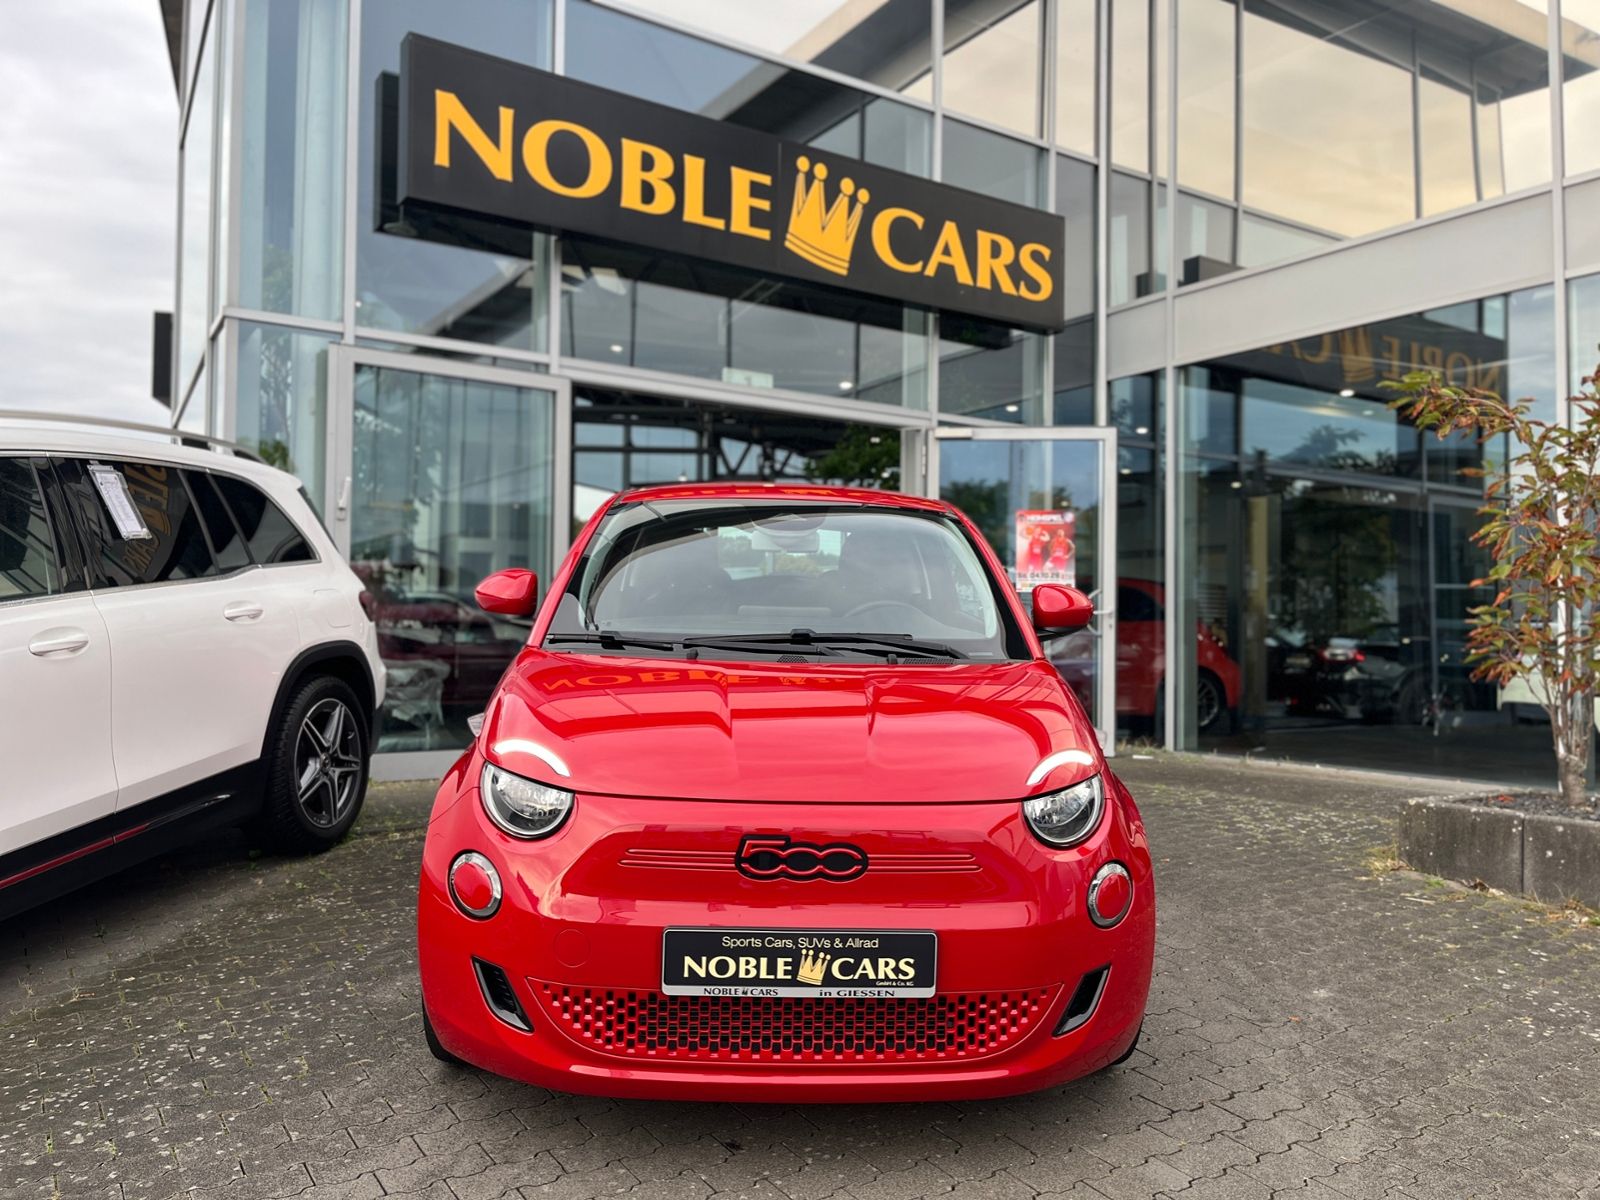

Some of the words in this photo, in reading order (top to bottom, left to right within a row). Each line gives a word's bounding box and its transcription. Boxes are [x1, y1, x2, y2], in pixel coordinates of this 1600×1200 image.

[434, 88, 772, 241] NOBLE
[871, 207, 1053, 302] CARS
[735, 834, 869, 883] 500
[721, 936, 762, 949] Sports
[764, 936, 796, 949] Cars,
[798, 937, 831, 949] SUVs
[833, 938, 843, 948] &
[845, 937, 879, 949] Allrad
[683, 955, 793, 980] NOBLE
[831, 957, 915, 980] CARS
[703, 987, 740, 996] NOBLE
[750, 987, 778, 996] CARS
[819, 989, 832, 997] in
[836, 989, 895, 997] GIESSEN
